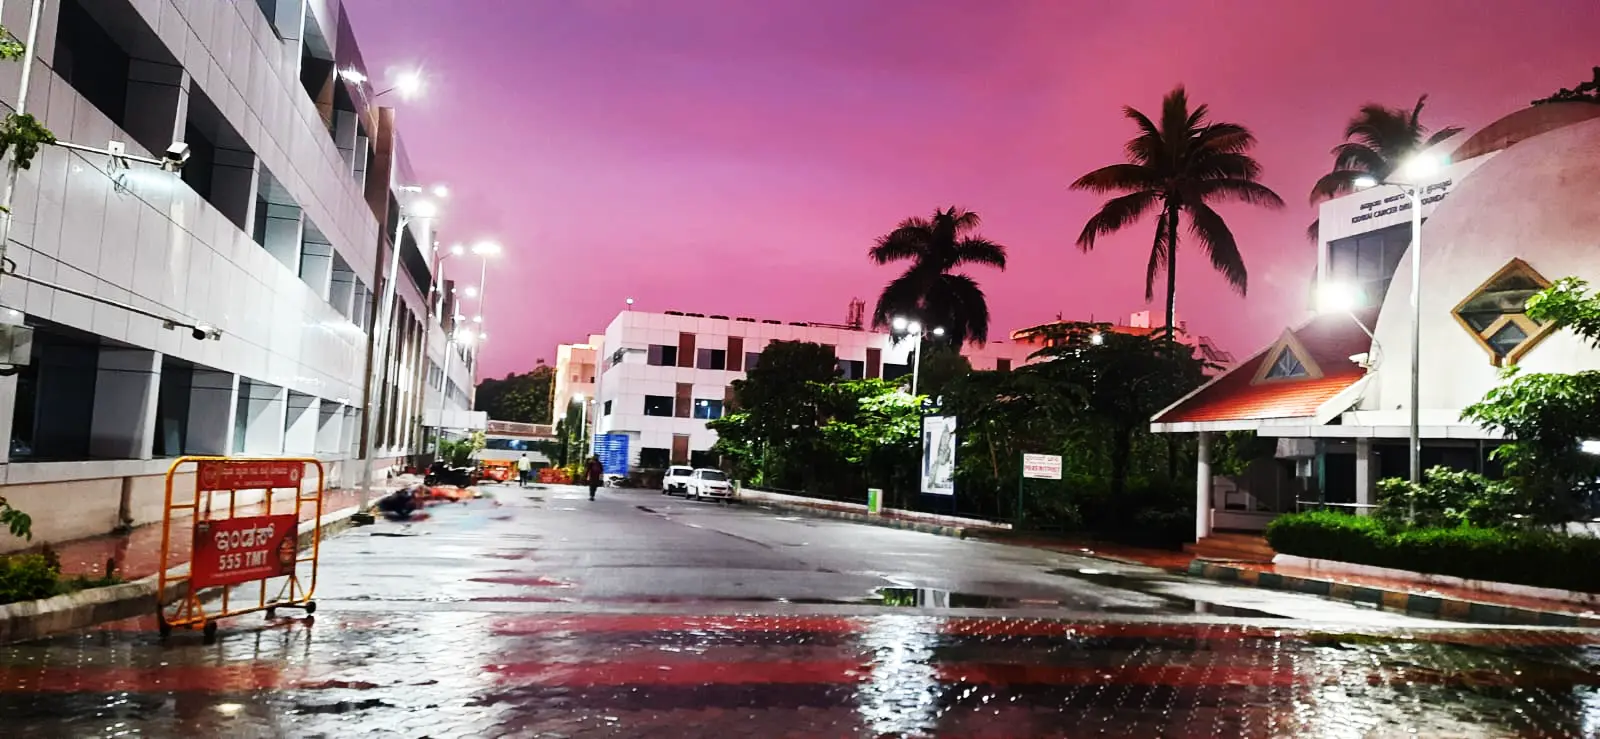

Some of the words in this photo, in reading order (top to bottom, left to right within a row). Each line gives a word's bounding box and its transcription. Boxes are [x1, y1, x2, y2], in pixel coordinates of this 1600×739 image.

[1373, 206, 1398, 218] CANCER
[1399, 201, 1413, 212] DRU
[218, 553, 242, 571] 555
[245, 550, 269, 567] TMT
